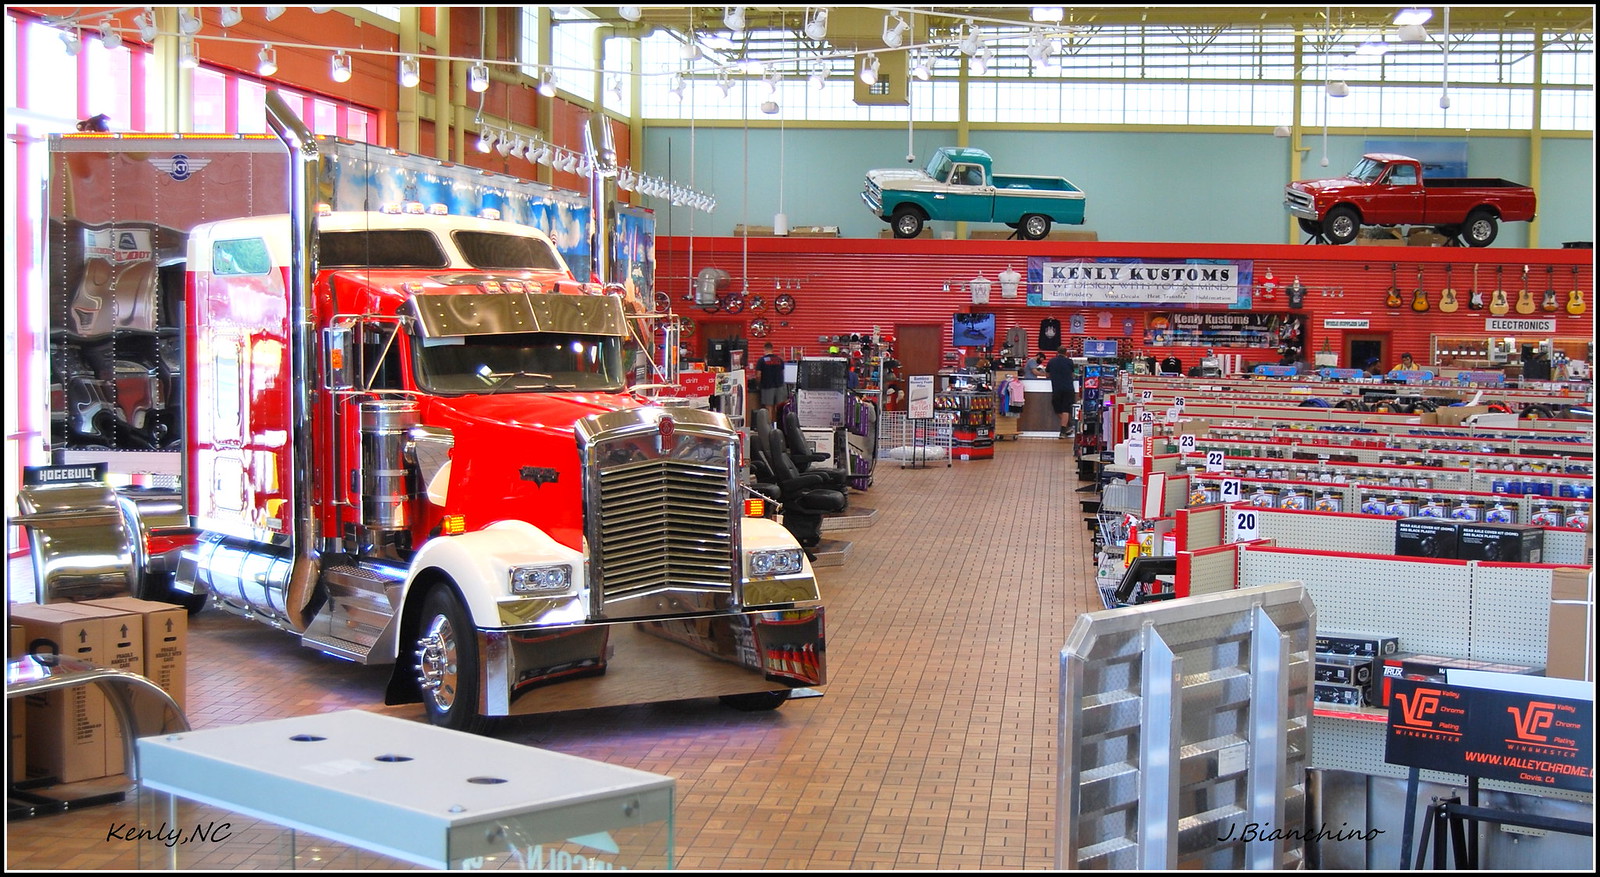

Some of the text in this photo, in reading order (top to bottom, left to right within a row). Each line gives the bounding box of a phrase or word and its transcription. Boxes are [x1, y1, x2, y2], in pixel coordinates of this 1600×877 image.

[173, 163, 186, 172] KT
[1051, 266, 1230, 282] KENLY KUSTOMS
[1174, 313, 1250, 325] Kenly Kustoms
[1492, 320, 1550, 330] ELECTRONICS
[1143, 391, 1152, 399] 27
[1175, 397, 1184, 406] 26
[1142, 413, 1152, 421] 25
[1131, 423, 1142, 434] 24
[1181, 436, 1194, 447] 23
[1209, 453, 1222, 465] 22
[40, 467, 96, 481] HOGEBUILT
[1223, 481, 1239, 495] 21
[1237, 513, 1255, 530] 20
[1383, 666, 1403, 677] TRUX
[1442, 690, 1460, 699] Valley
[1440, 705, 1465, 715] Chrome
[1557, 703, 1576, 713] Valley
[1439, 721, 1460, 731] Plating
[1555, 720, 1581, 729] Chrome
[1395, 729, 1460, 742] WINGMASTER
[1553, 736, 1576, 746] Plating
[1507, 744, 1576, 758] WINGMASTER
